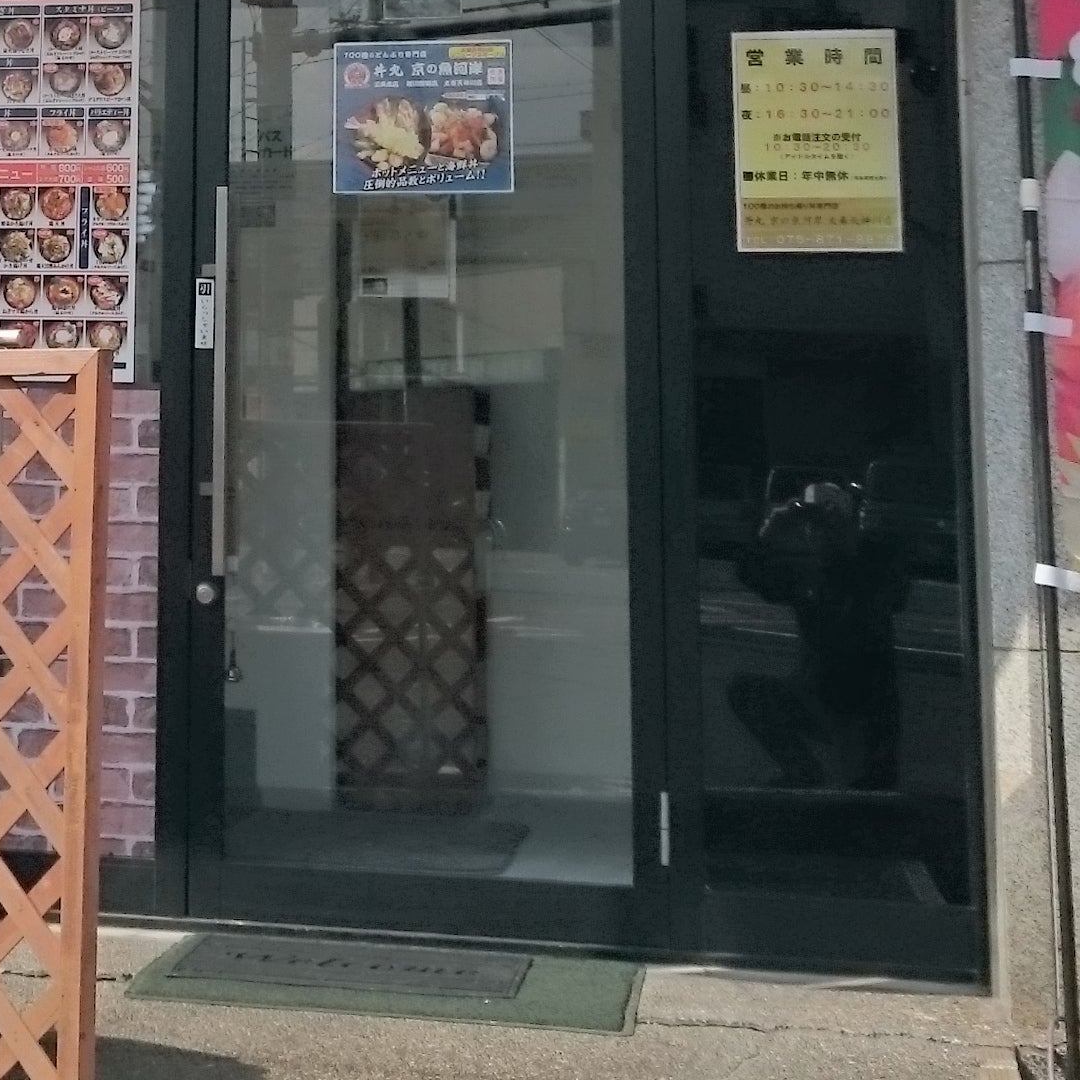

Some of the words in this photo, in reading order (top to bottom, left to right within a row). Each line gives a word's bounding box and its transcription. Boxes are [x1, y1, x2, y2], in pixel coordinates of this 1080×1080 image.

[746, 47, 883, 66] 営業時間
[200, 283, 211, 295] 引
